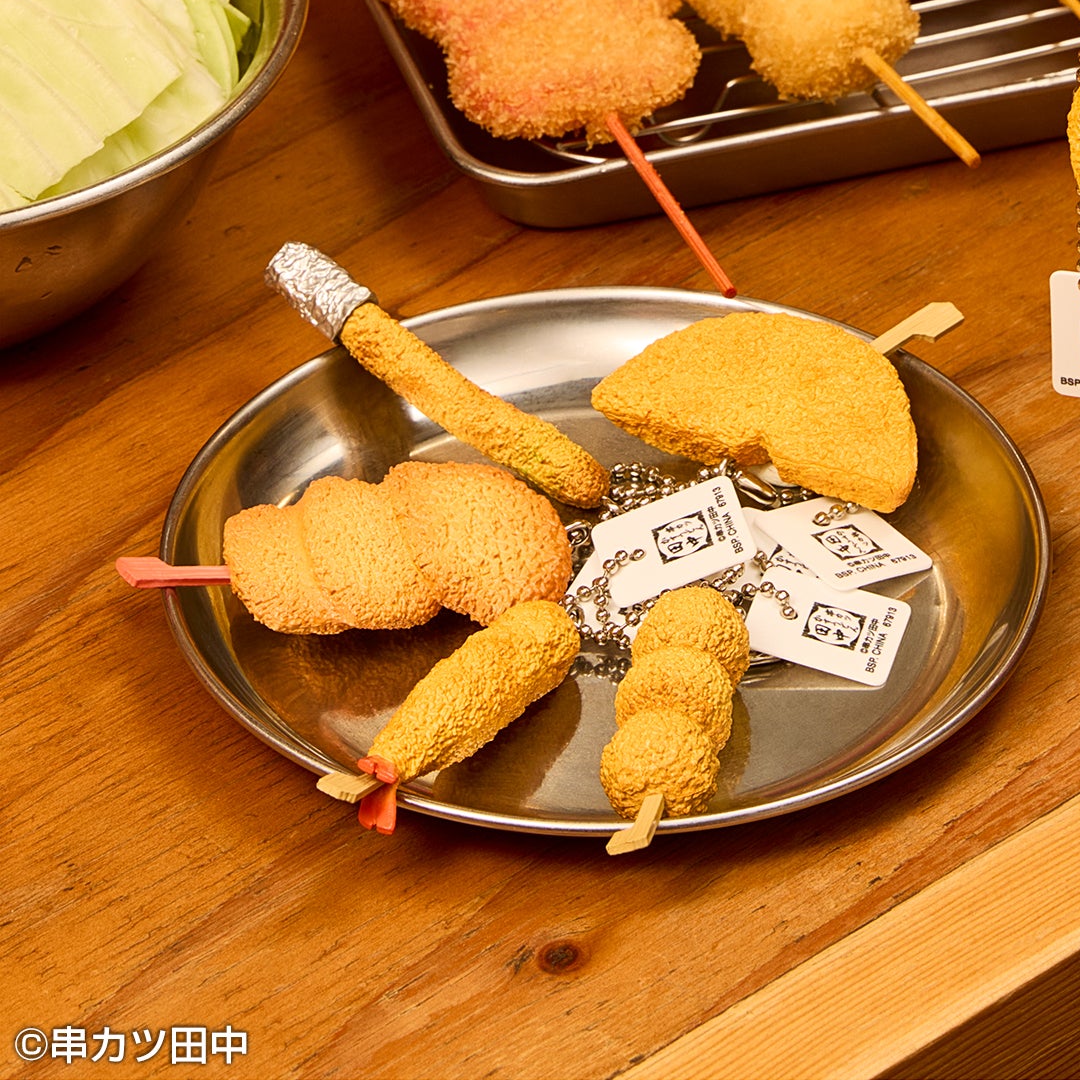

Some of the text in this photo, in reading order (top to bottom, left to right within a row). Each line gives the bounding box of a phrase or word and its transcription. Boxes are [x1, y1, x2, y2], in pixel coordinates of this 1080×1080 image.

[712, 486, 744, 554] BSP. CHINA 67913
[857, 561, 886, 574] CHINA
[864, 606, 898, 674] BSP. CHINA 67913
